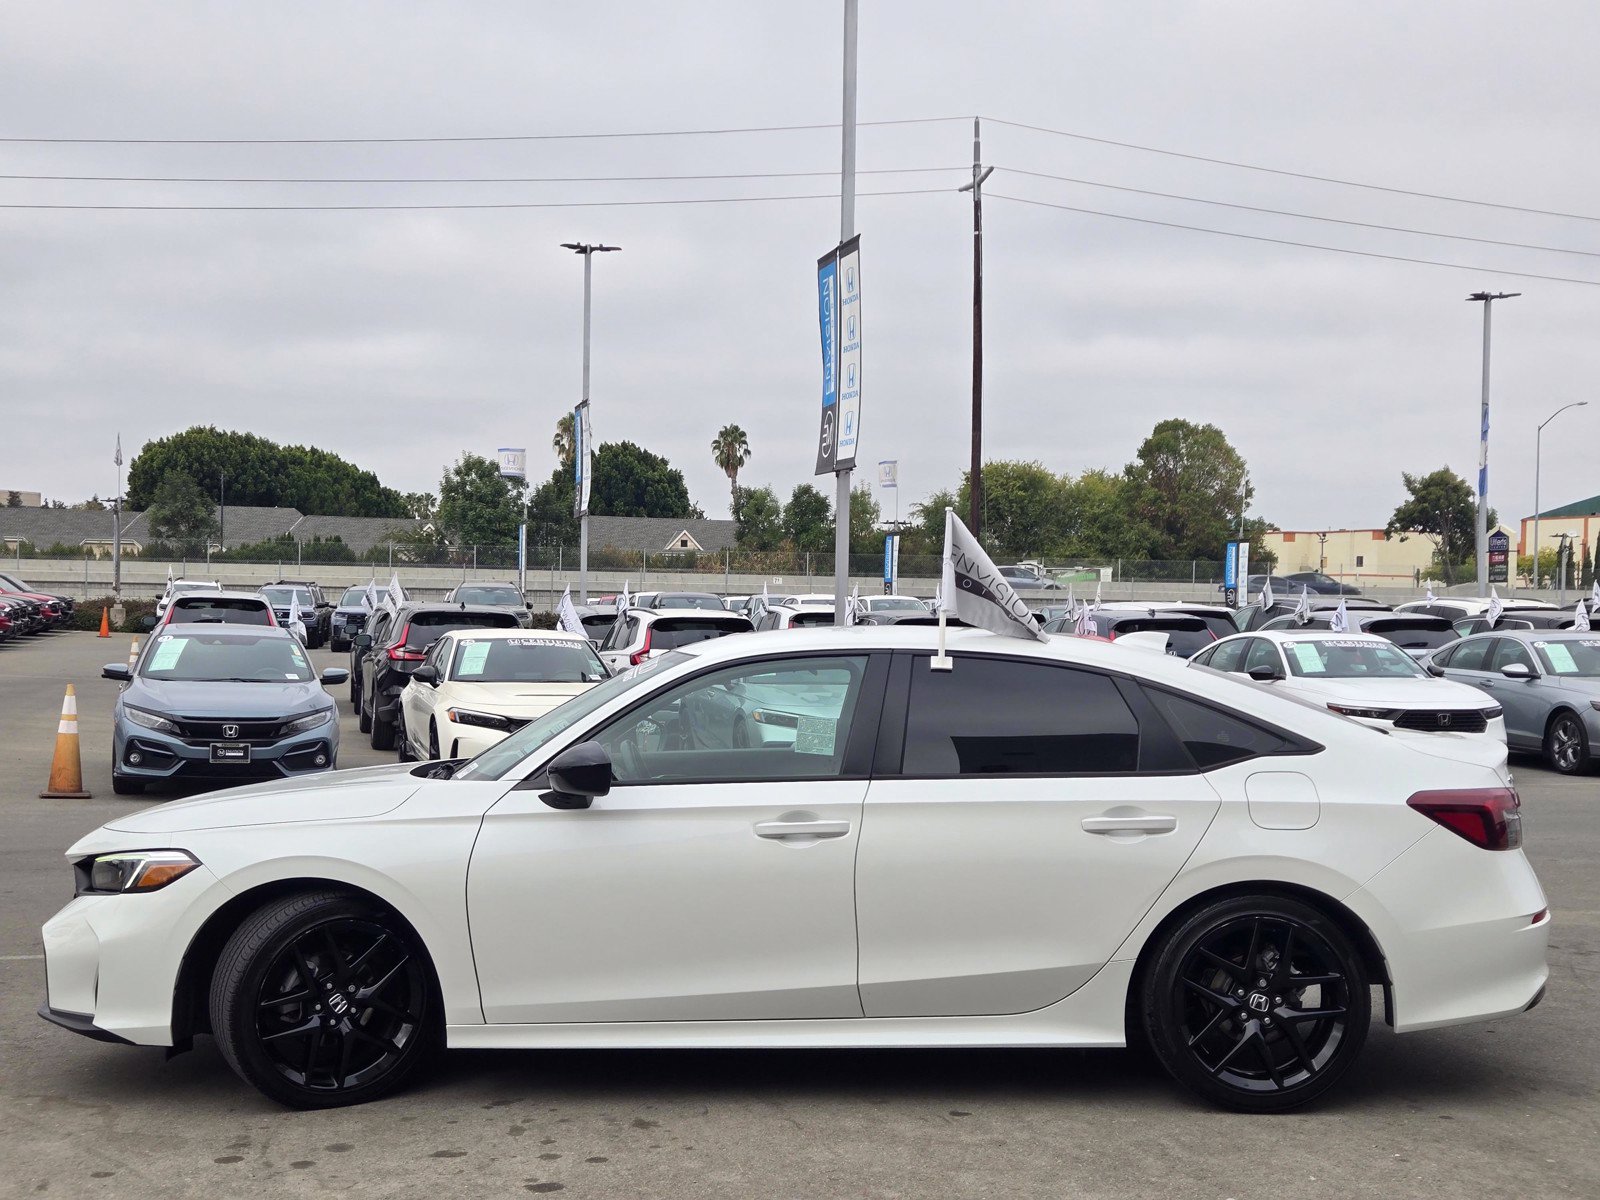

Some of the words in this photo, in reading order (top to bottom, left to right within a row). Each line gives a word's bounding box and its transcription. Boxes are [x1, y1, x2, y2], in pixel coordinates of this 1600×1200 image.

[842, 293, 859, 306] HONDA
[822, 276, 832, 396] ENVISION
[842, 341, 860, 354] HONDA
[841, 389, 859, 401] HONDA
[839, 438, 855, 448] HONDA
[521, 639, 582, 648] CERTIFIED
